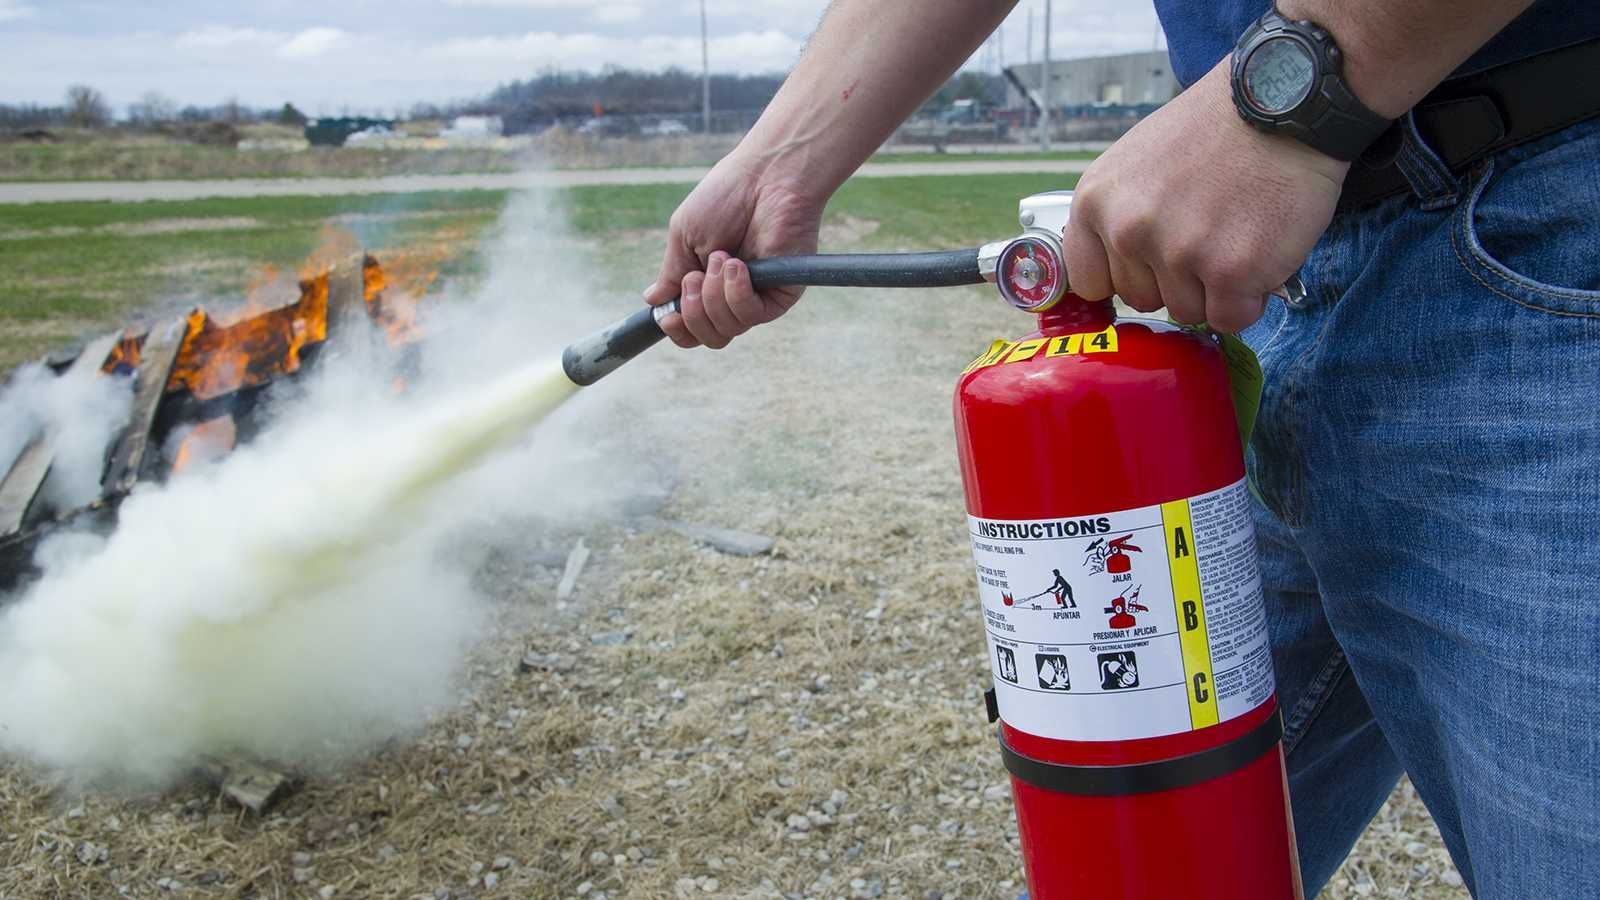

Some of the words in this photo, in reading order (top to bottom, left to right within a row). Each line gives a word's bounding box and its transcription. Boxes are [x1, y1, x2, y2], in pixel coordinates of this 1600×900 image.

[978, 517, 1111, 539] INSTRUCTIONS
[1174, 526, 1189, 559] A
[1112, 573, 1132, 583] JALAR
[1031, 603, 1042, 611] 3m
[1053, 611, 1081, 620] APUNTAR
[1182, 600, 1198, 632] B
[1093, 630, 1125, 641] PRESIONAR
[1125, 630, 1130, 638] Y
[1134, 626, 1157, 636] APLICAR
[1124, 641, 1149, 649] EQUIPMENT
[1193, 672, 1208, 703] C
